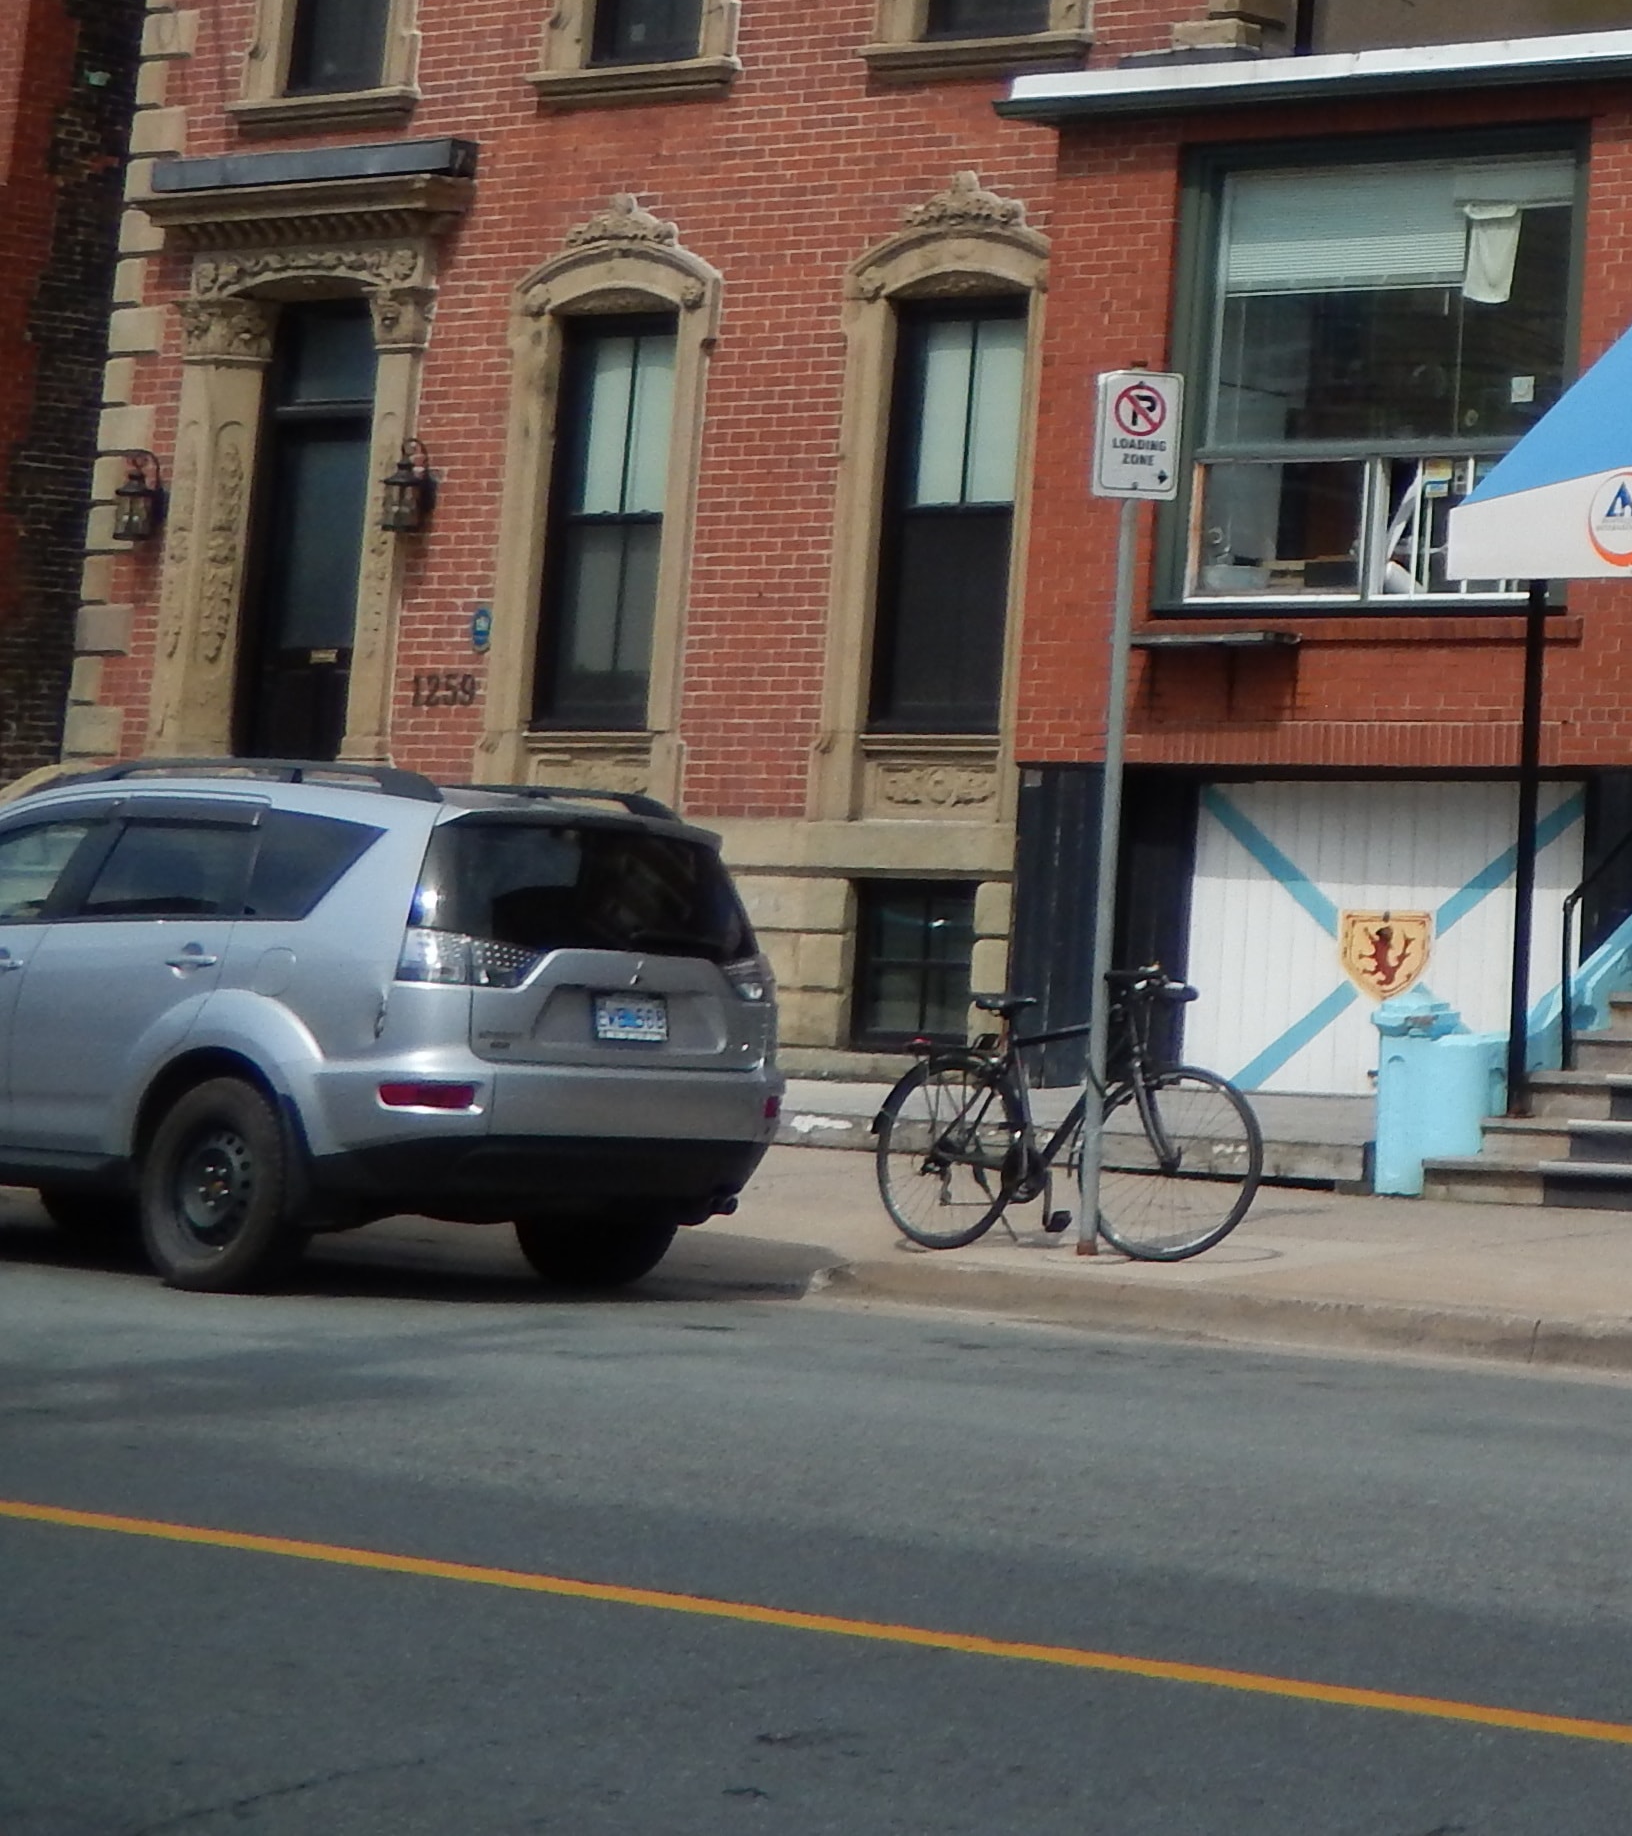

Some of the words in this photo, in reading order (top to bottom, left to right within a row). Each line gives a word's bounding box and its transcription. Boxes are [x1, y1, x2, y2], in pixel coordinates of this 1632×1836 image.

[1111, 437, 1167, 452] LOADING
[1121, 453, 1156, 466] ZONE
[412, 673, 476, 707] 1259
